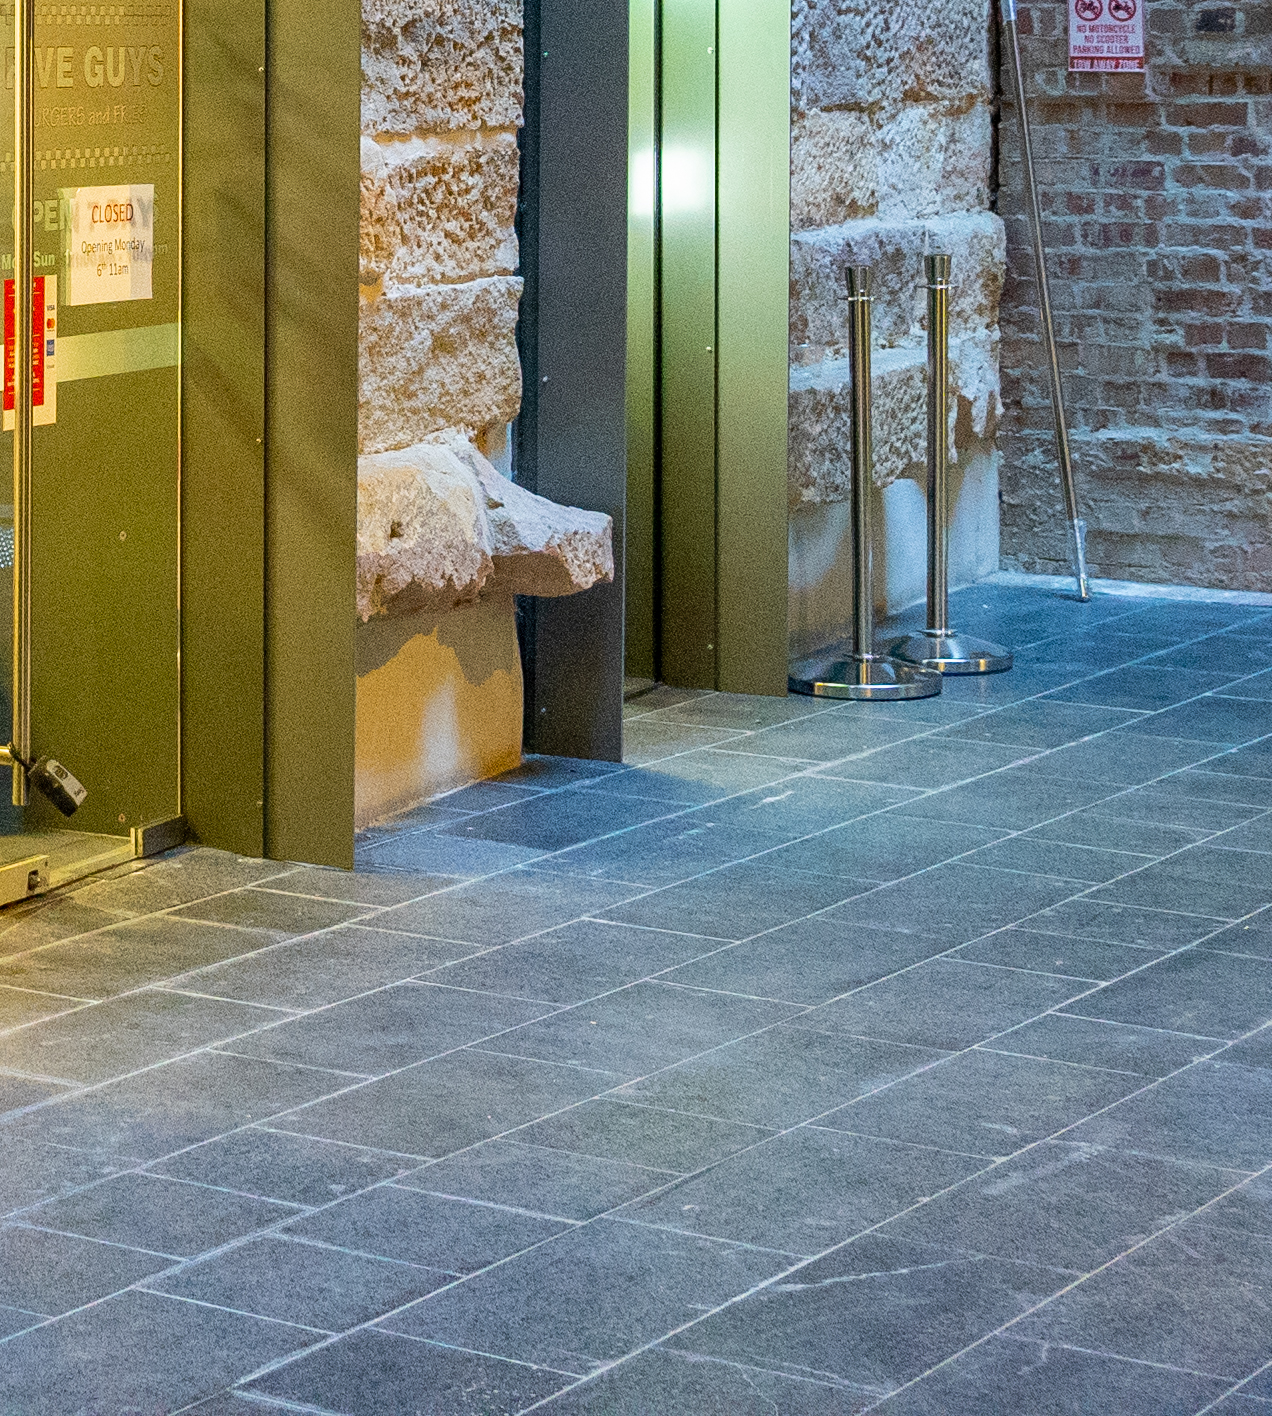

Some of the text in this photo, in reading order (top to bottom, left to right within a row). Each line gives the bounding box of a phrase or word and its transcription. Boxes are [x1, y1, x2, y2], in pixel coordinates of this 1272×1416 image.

[5, 44, 165, 89] FVE GUYS
[92, 203, 134, 224] CLOSED
[81, 240, 113, 255] Opening
[114, 237, 145, 253] Monday
[33, 251, 55, 268] Sun
[109, 261, 128, 276] 11am
